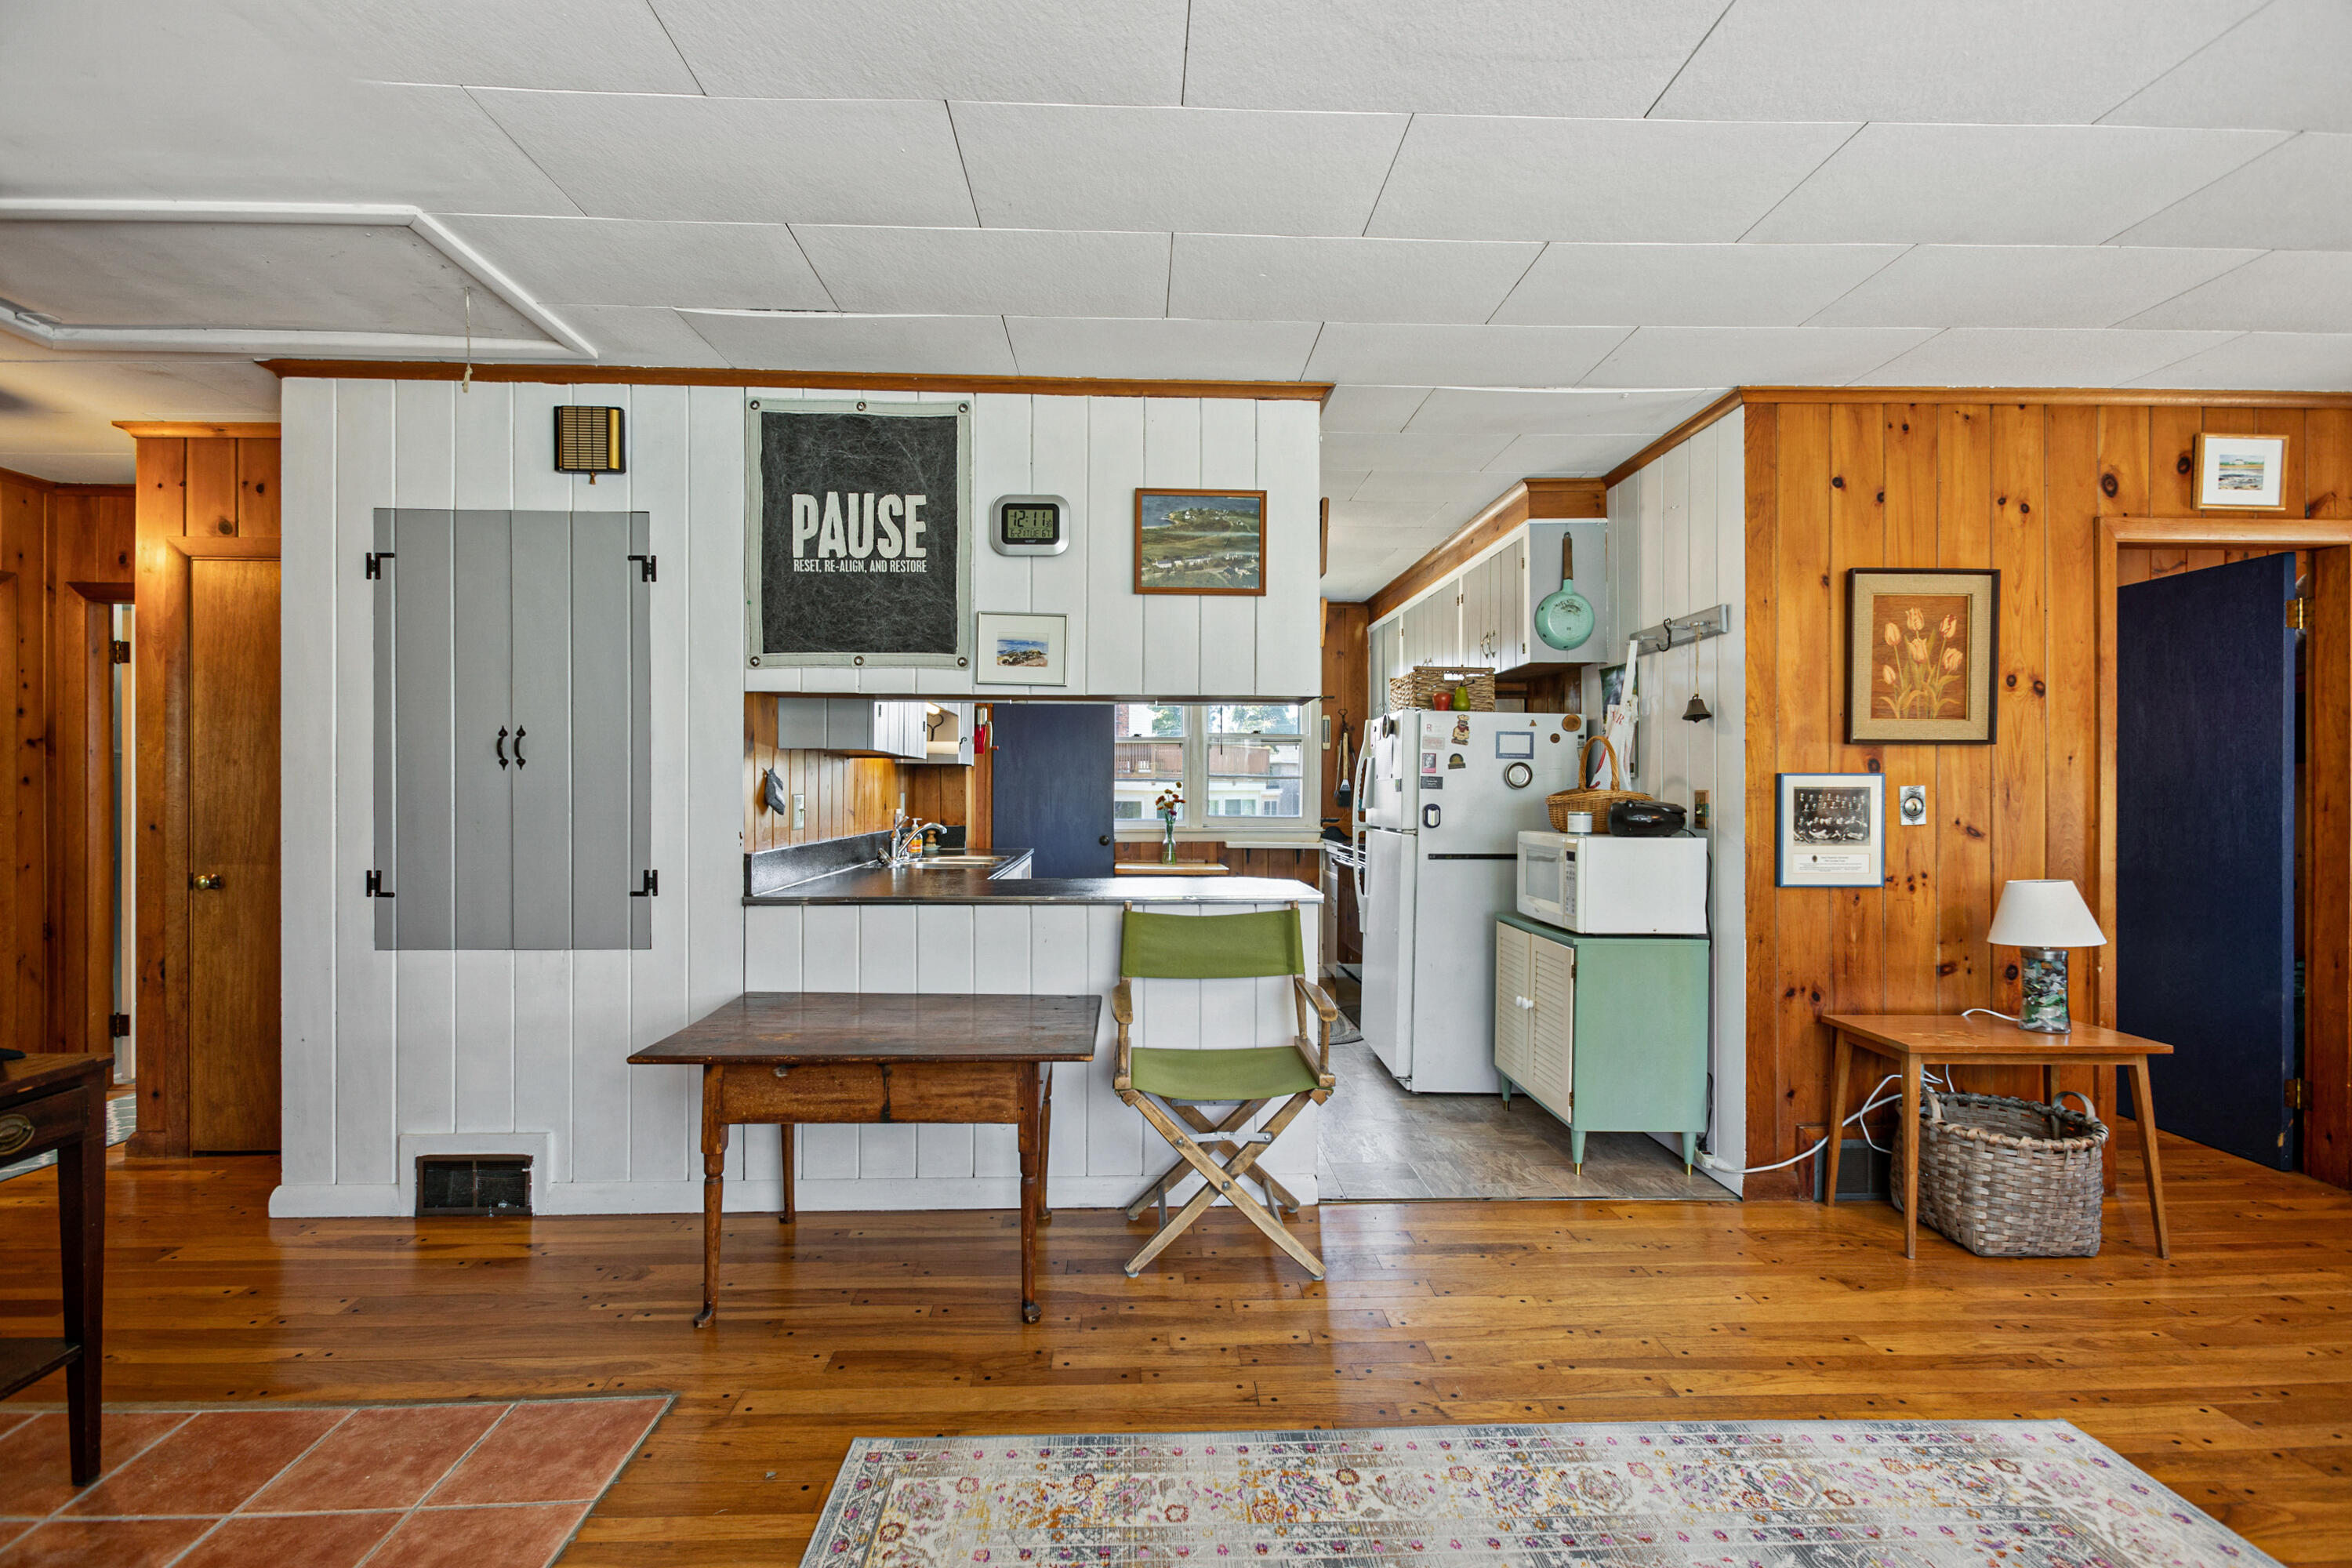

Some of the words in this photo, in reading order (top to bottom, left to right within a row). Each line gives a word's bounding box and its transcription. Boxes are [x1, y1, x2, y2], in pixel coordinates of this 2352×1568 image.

[792, 492, 927, 559] PAUSE
[1014, 510, 1045, 527] 12:11
[793, 559, 822, 573] RESET,
[824, 560, 867, 573] RE-ALIGN,
[869, 560, 887, 572] AND
[890, 560, 927, 573] RESTORE
